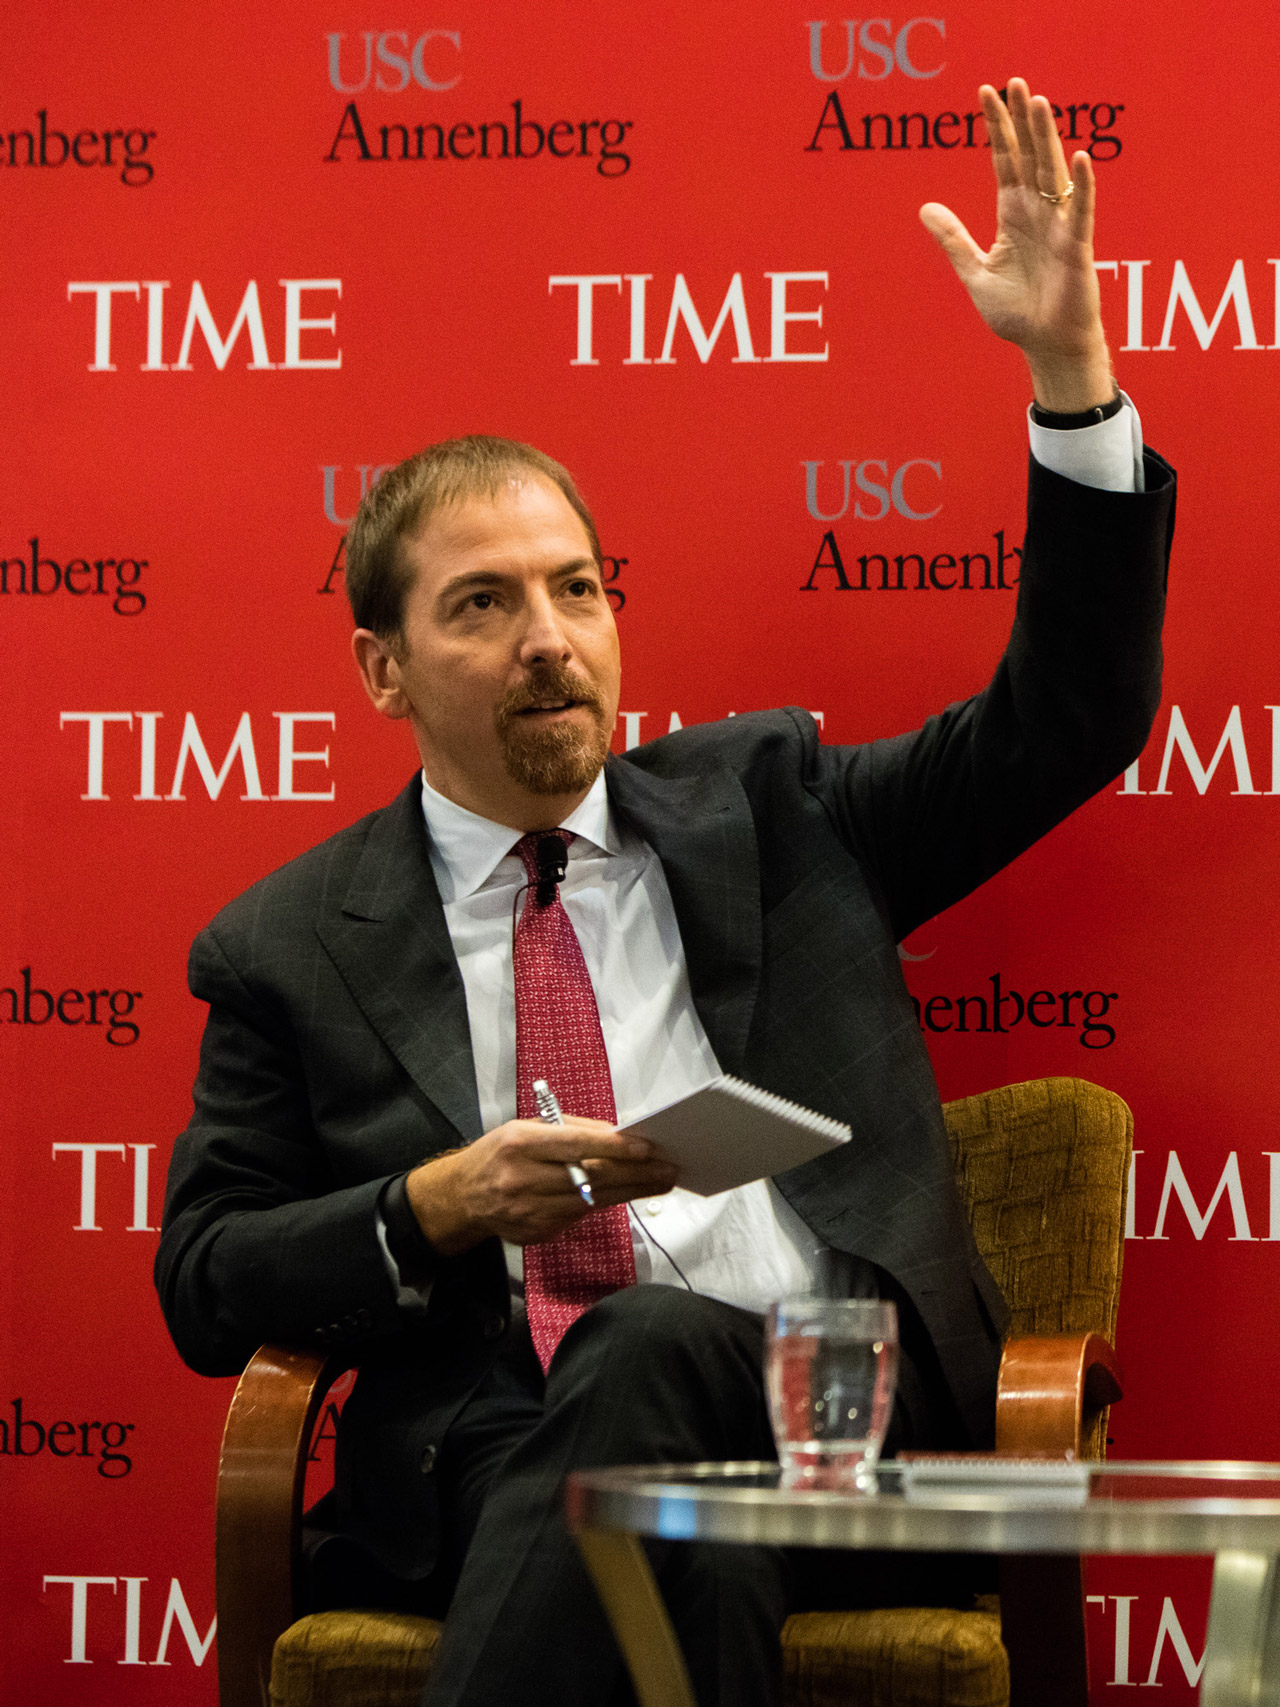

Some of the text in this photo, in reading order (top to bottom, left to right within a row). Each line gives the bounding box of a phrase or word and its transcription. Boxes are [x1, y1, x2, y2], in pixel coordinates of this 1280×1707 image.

[325, 30, 464, 94] USC
[805, 17, 947, 81] USC
[0, 109, 157, 187] nberg
[322, 100, 634, 178] Annenberg
[804, 90, 1125, 161] Annenrg
[67, 279, 342, 371] TIME
[548, 272, 829, 364] TIME
[800, 458, 944, 521] USC
[0, 536, 149, 616] nberg
[59, 711, 335, 801] TIME
[52, 1142, 161, 1231] TI
